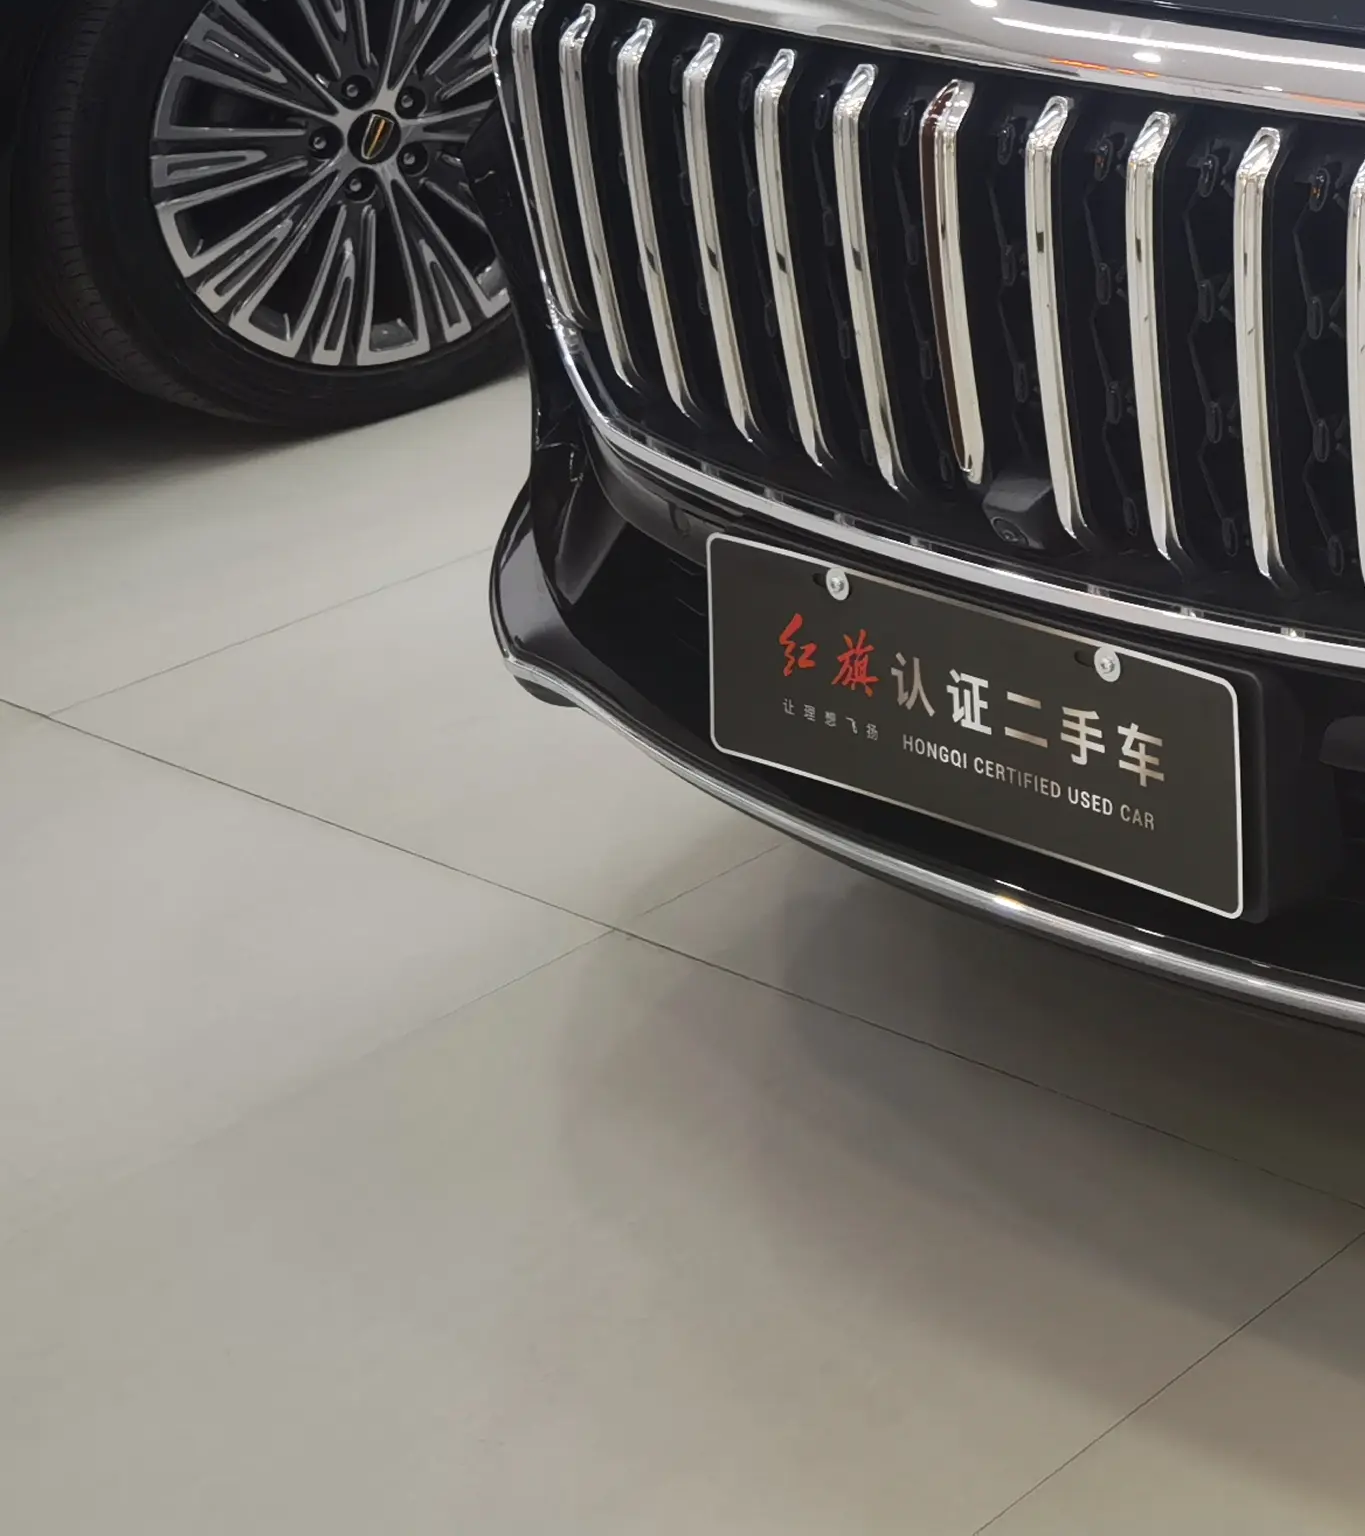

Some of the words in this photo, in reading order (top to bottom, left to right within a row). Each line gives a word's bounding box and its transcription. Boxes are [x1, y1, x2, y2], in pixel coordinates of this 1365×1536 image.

[902, 734, 968, 769] HONGQI
[973, 756, 1061, 798] CERTIFIED
[1067, 786, 1114, 815] USED
[1120, 804, 1155, 830] CAR
